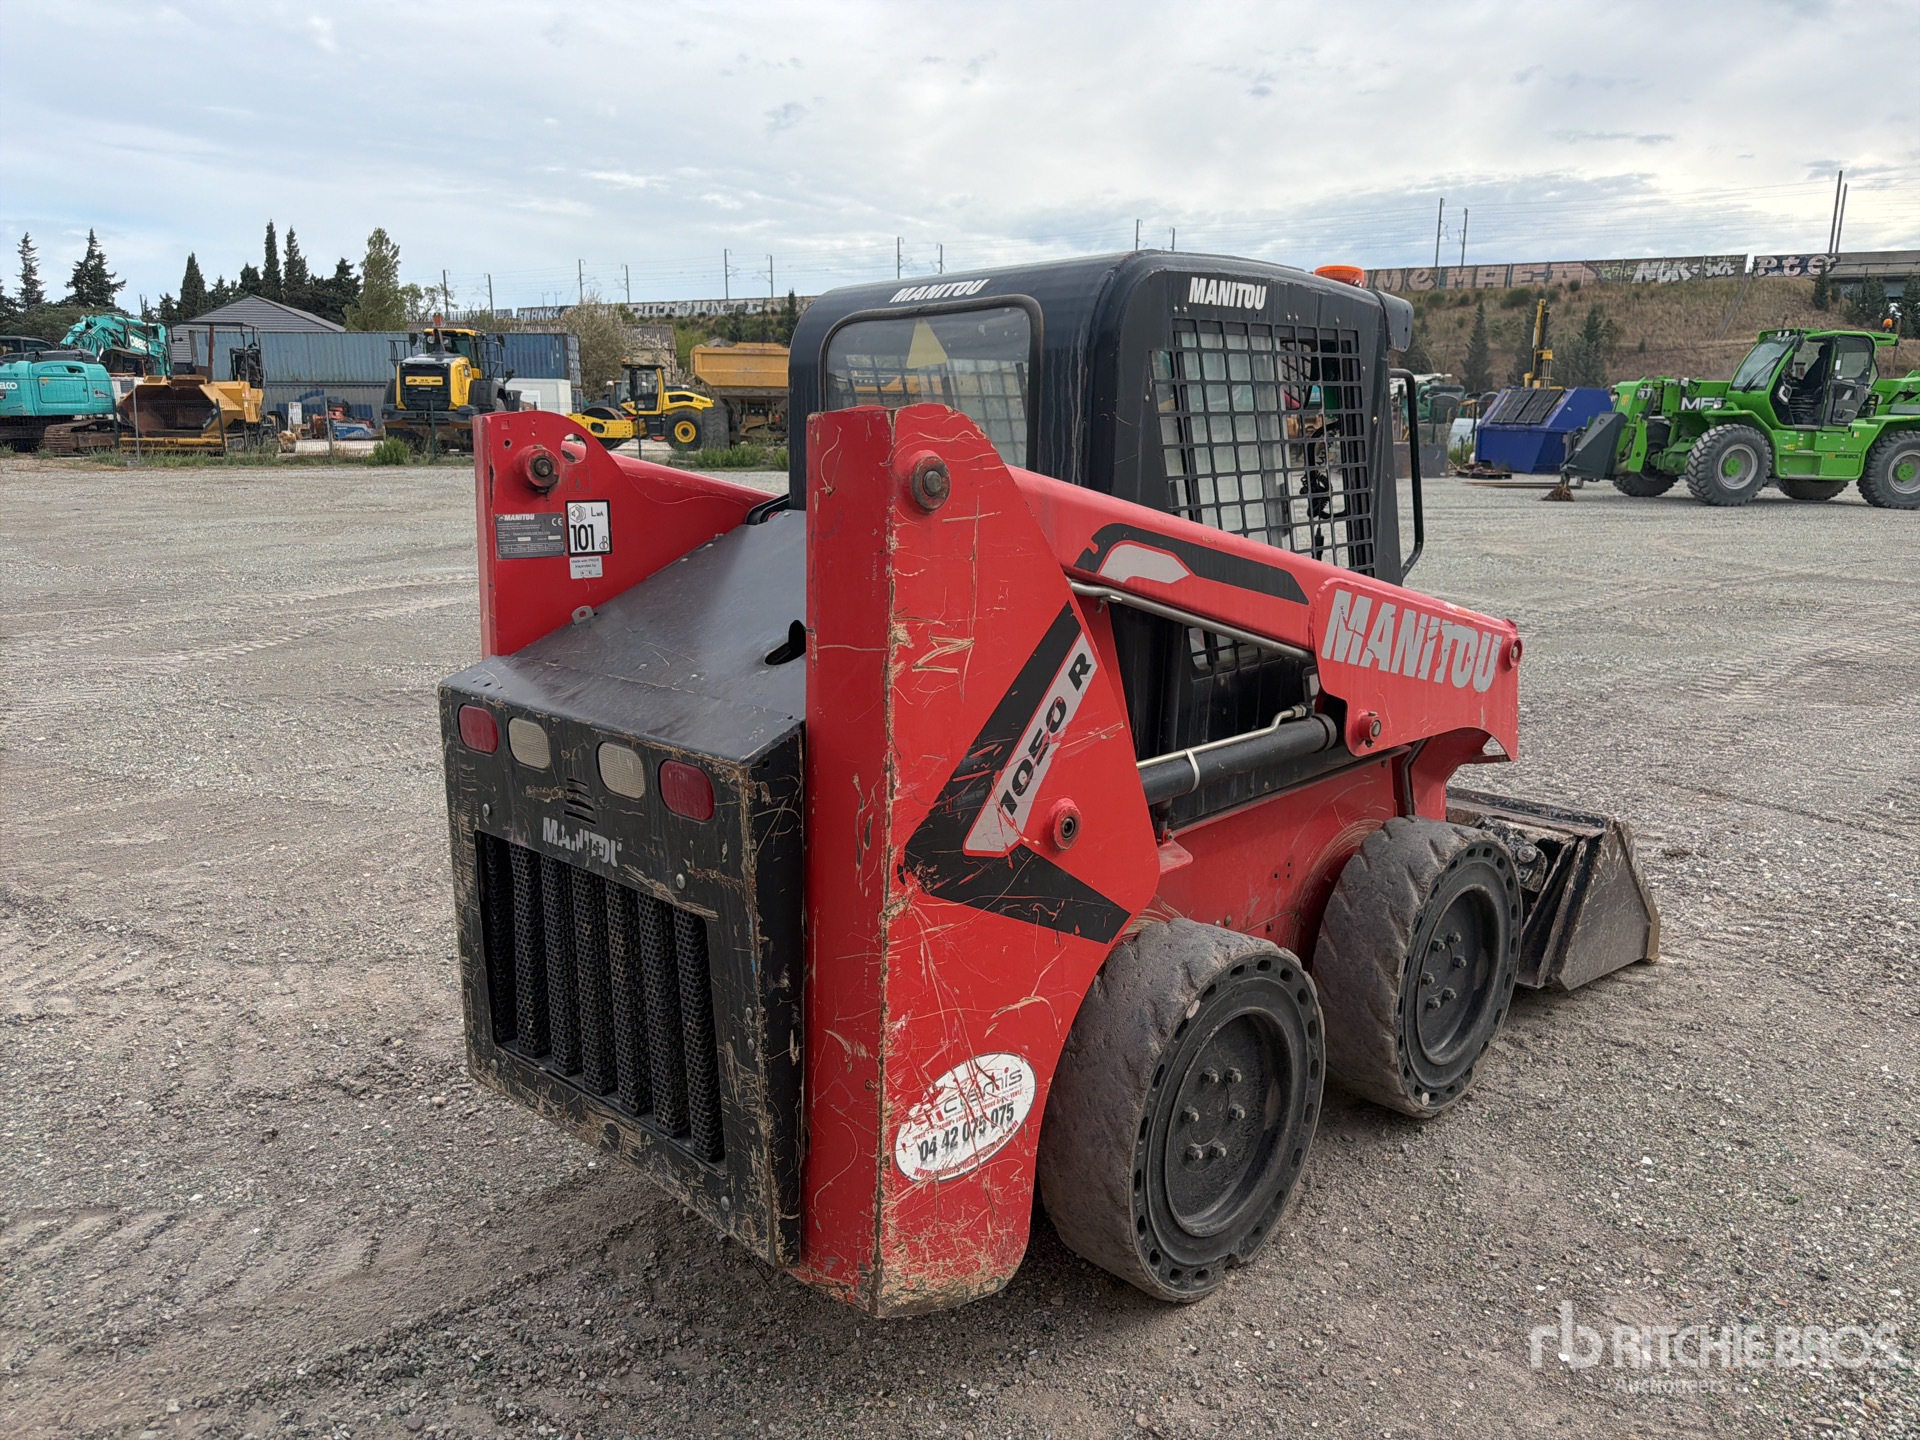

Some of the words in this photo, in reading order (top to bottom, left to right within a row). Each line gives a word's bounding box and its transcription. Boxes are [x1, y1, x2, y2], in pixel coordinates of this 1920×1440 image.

[889, 279, 990, 303] MANITOU
[1189, 277, 1267, 310] MANITOU
[504, 513, 535, 521] MANITOU
[570, 524, 595, 551] 101
[1321, 588, 1503, 693] MANITOU
[1000, 696, 1067, 816] 1050
[1068, 652, 1092, 691] R
[919, 1136, 938, 1161] 04
[941, 1126, 959, 1149] 42
[990, 1102, 1014, 1129] 075
